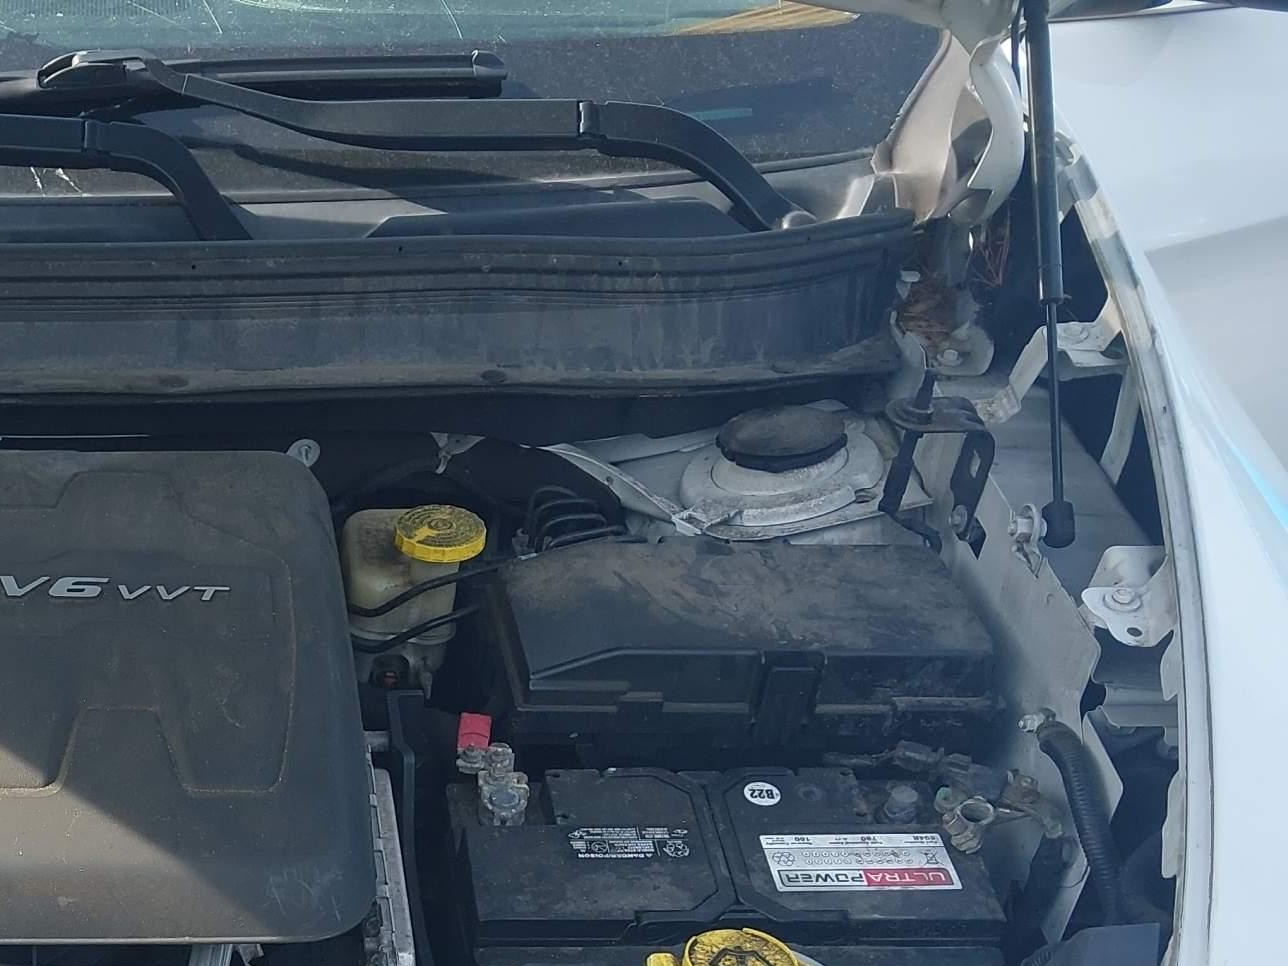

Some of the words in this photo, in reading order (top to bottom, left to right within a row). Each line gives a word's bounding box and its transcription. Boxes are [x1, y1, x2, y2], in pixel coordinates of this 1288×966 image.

[0, 575, 110, 598] V6
[118, 584, 231, 601] VVT
[748, 788, 776, 800] B22
